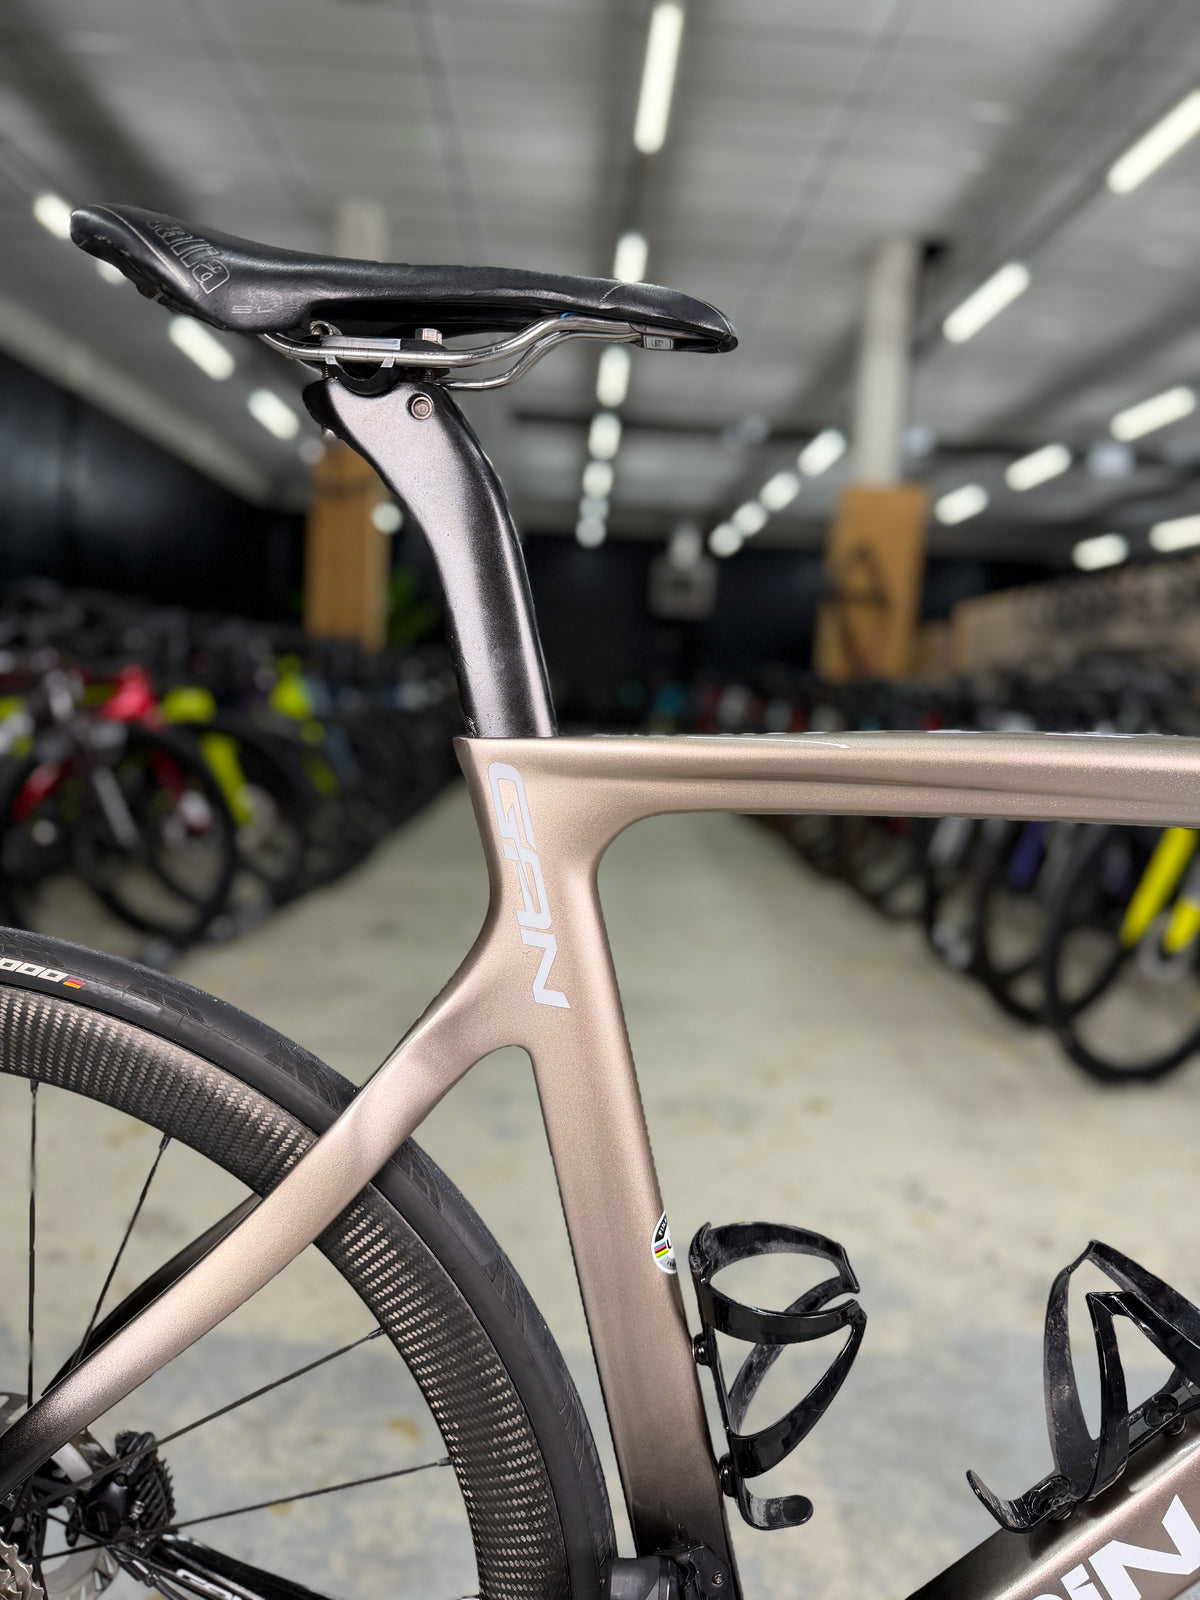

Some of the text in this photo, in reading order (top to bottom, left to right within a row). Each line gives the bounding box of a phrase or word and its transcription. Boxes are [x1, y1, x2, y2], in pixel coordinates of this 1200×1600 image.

[232, 305, 272, 313] SL
[488, 762, 571, 1008] GAN
[1033, 1494, 1200, 1600] iN
